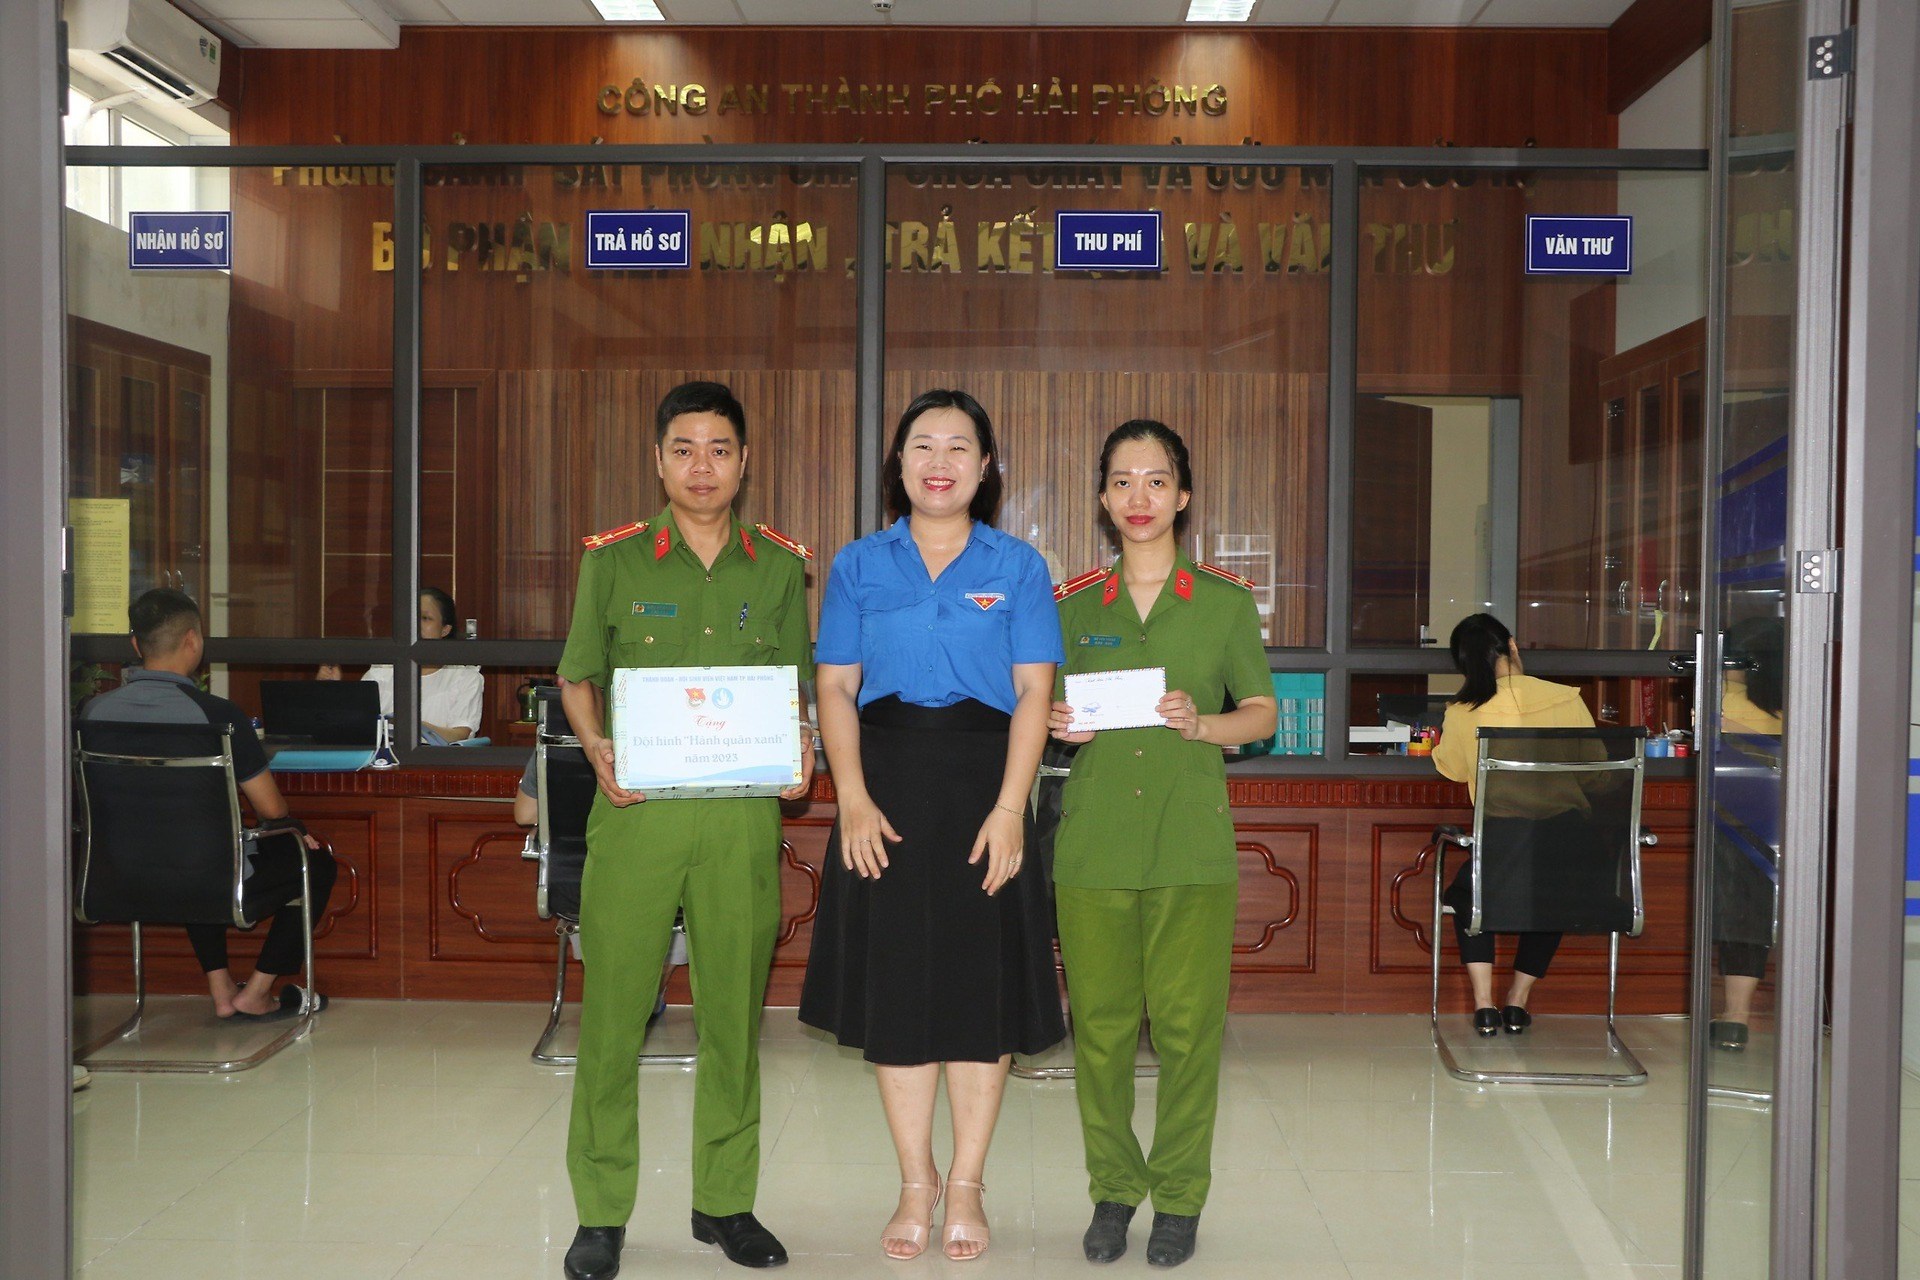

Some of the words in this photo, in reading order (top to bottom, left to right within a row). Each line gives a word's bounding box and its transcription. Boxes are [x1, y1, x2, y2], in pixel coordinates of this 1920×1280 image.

[597, 77, 708, 116] CÔNG
[717, 84, 769, 115] AN
[781, 76, 910, 116] THÀNH
[1017, 76, 1079, 115] HẢI
[1092, 77, 1228, 116] PHÒNG
[136, 228, 177, 254] NHẬN
[181, 226, 200, 250] HỒ
[204, 230, 224, 250] SƠ
[446, 211, 571, 283] PHẬN
[699, 210, 828, 283] NHẬN
[1184, 211, 1244, 274] VÀ
[1364, 217, 1461, 275] THƯ
[595, 227, 627, 251] TRẢ
[631, 227, 653, 251] HỒ
[658, 231, 682, 251] SƠ
[1074, 233, 1108, 251] THU
[1112, 229, 1142, 251] PHÍ
[1545, 233, 1578, 255] VĂN
[1581, 236, 1614, 255] THƯ
[632, 735, 653, 748] Đội
[722, 734, 752, 747] quân
[685, 754, 710, 763] năm
[712, 752, 739, 763] 2023
